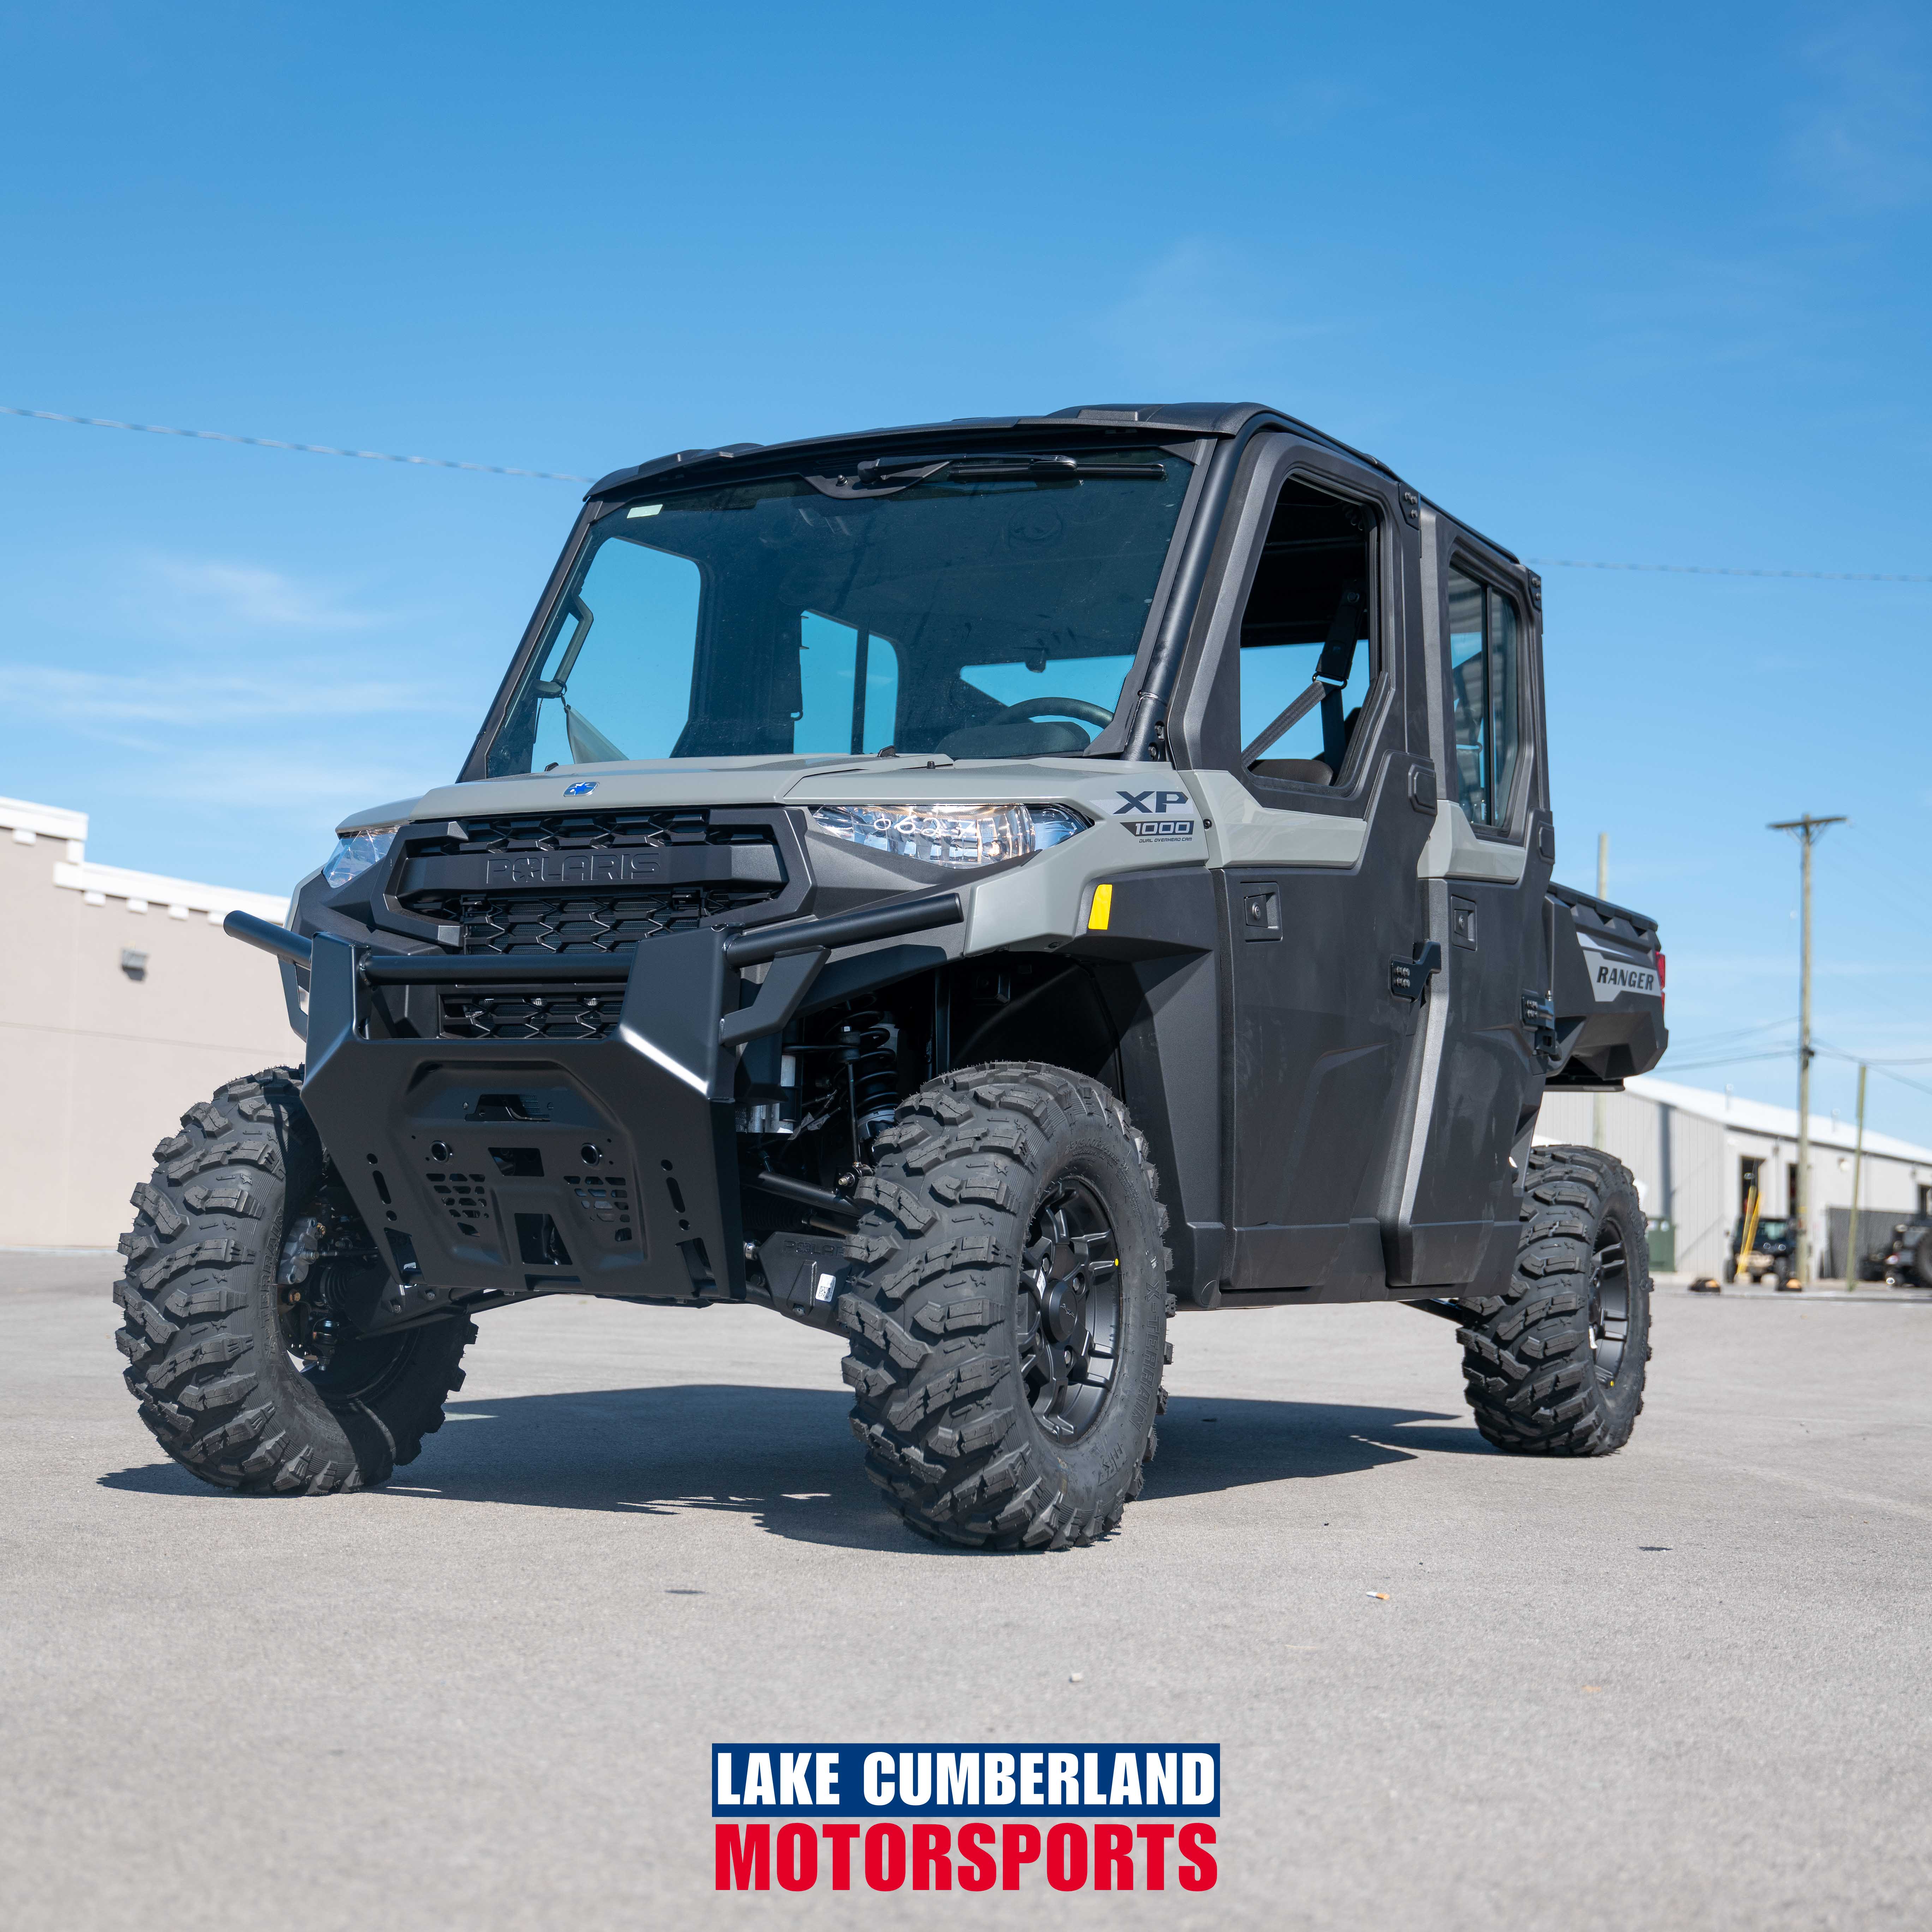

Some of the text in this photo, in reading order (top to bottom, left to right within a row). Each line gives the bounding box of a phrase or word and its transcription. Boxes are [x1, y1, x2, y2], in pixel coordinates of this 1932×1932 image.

[1113, 791, 1189, 814] XP
[1135, 822, 1190, 835] 1000
[486, 853, 660, 885] POLARIS
[1597, 966, 1654, 991] RANGER
[1129, 1280, 1160, 1432] X-TERRAIN
